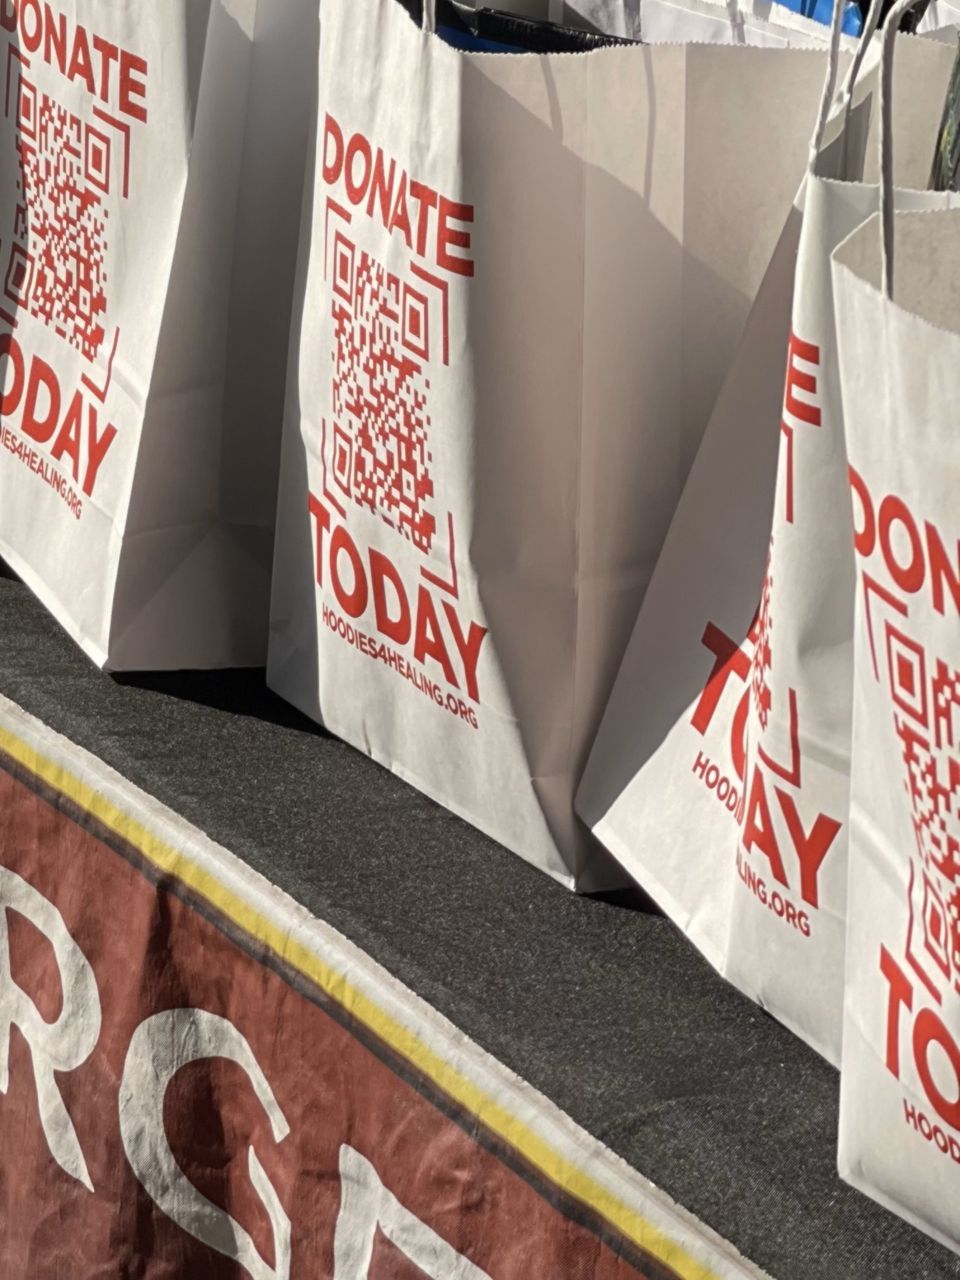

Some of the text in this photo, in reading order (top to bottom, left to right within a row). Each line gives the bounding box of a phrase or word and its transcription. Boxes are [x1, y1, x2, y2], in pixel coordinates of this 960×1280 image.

[323, 113, 475, 277] DONATE
[308, 491, 488, 705] TODAY
[322, 602, 479, 729] HOODIES4HEALING.ORG
